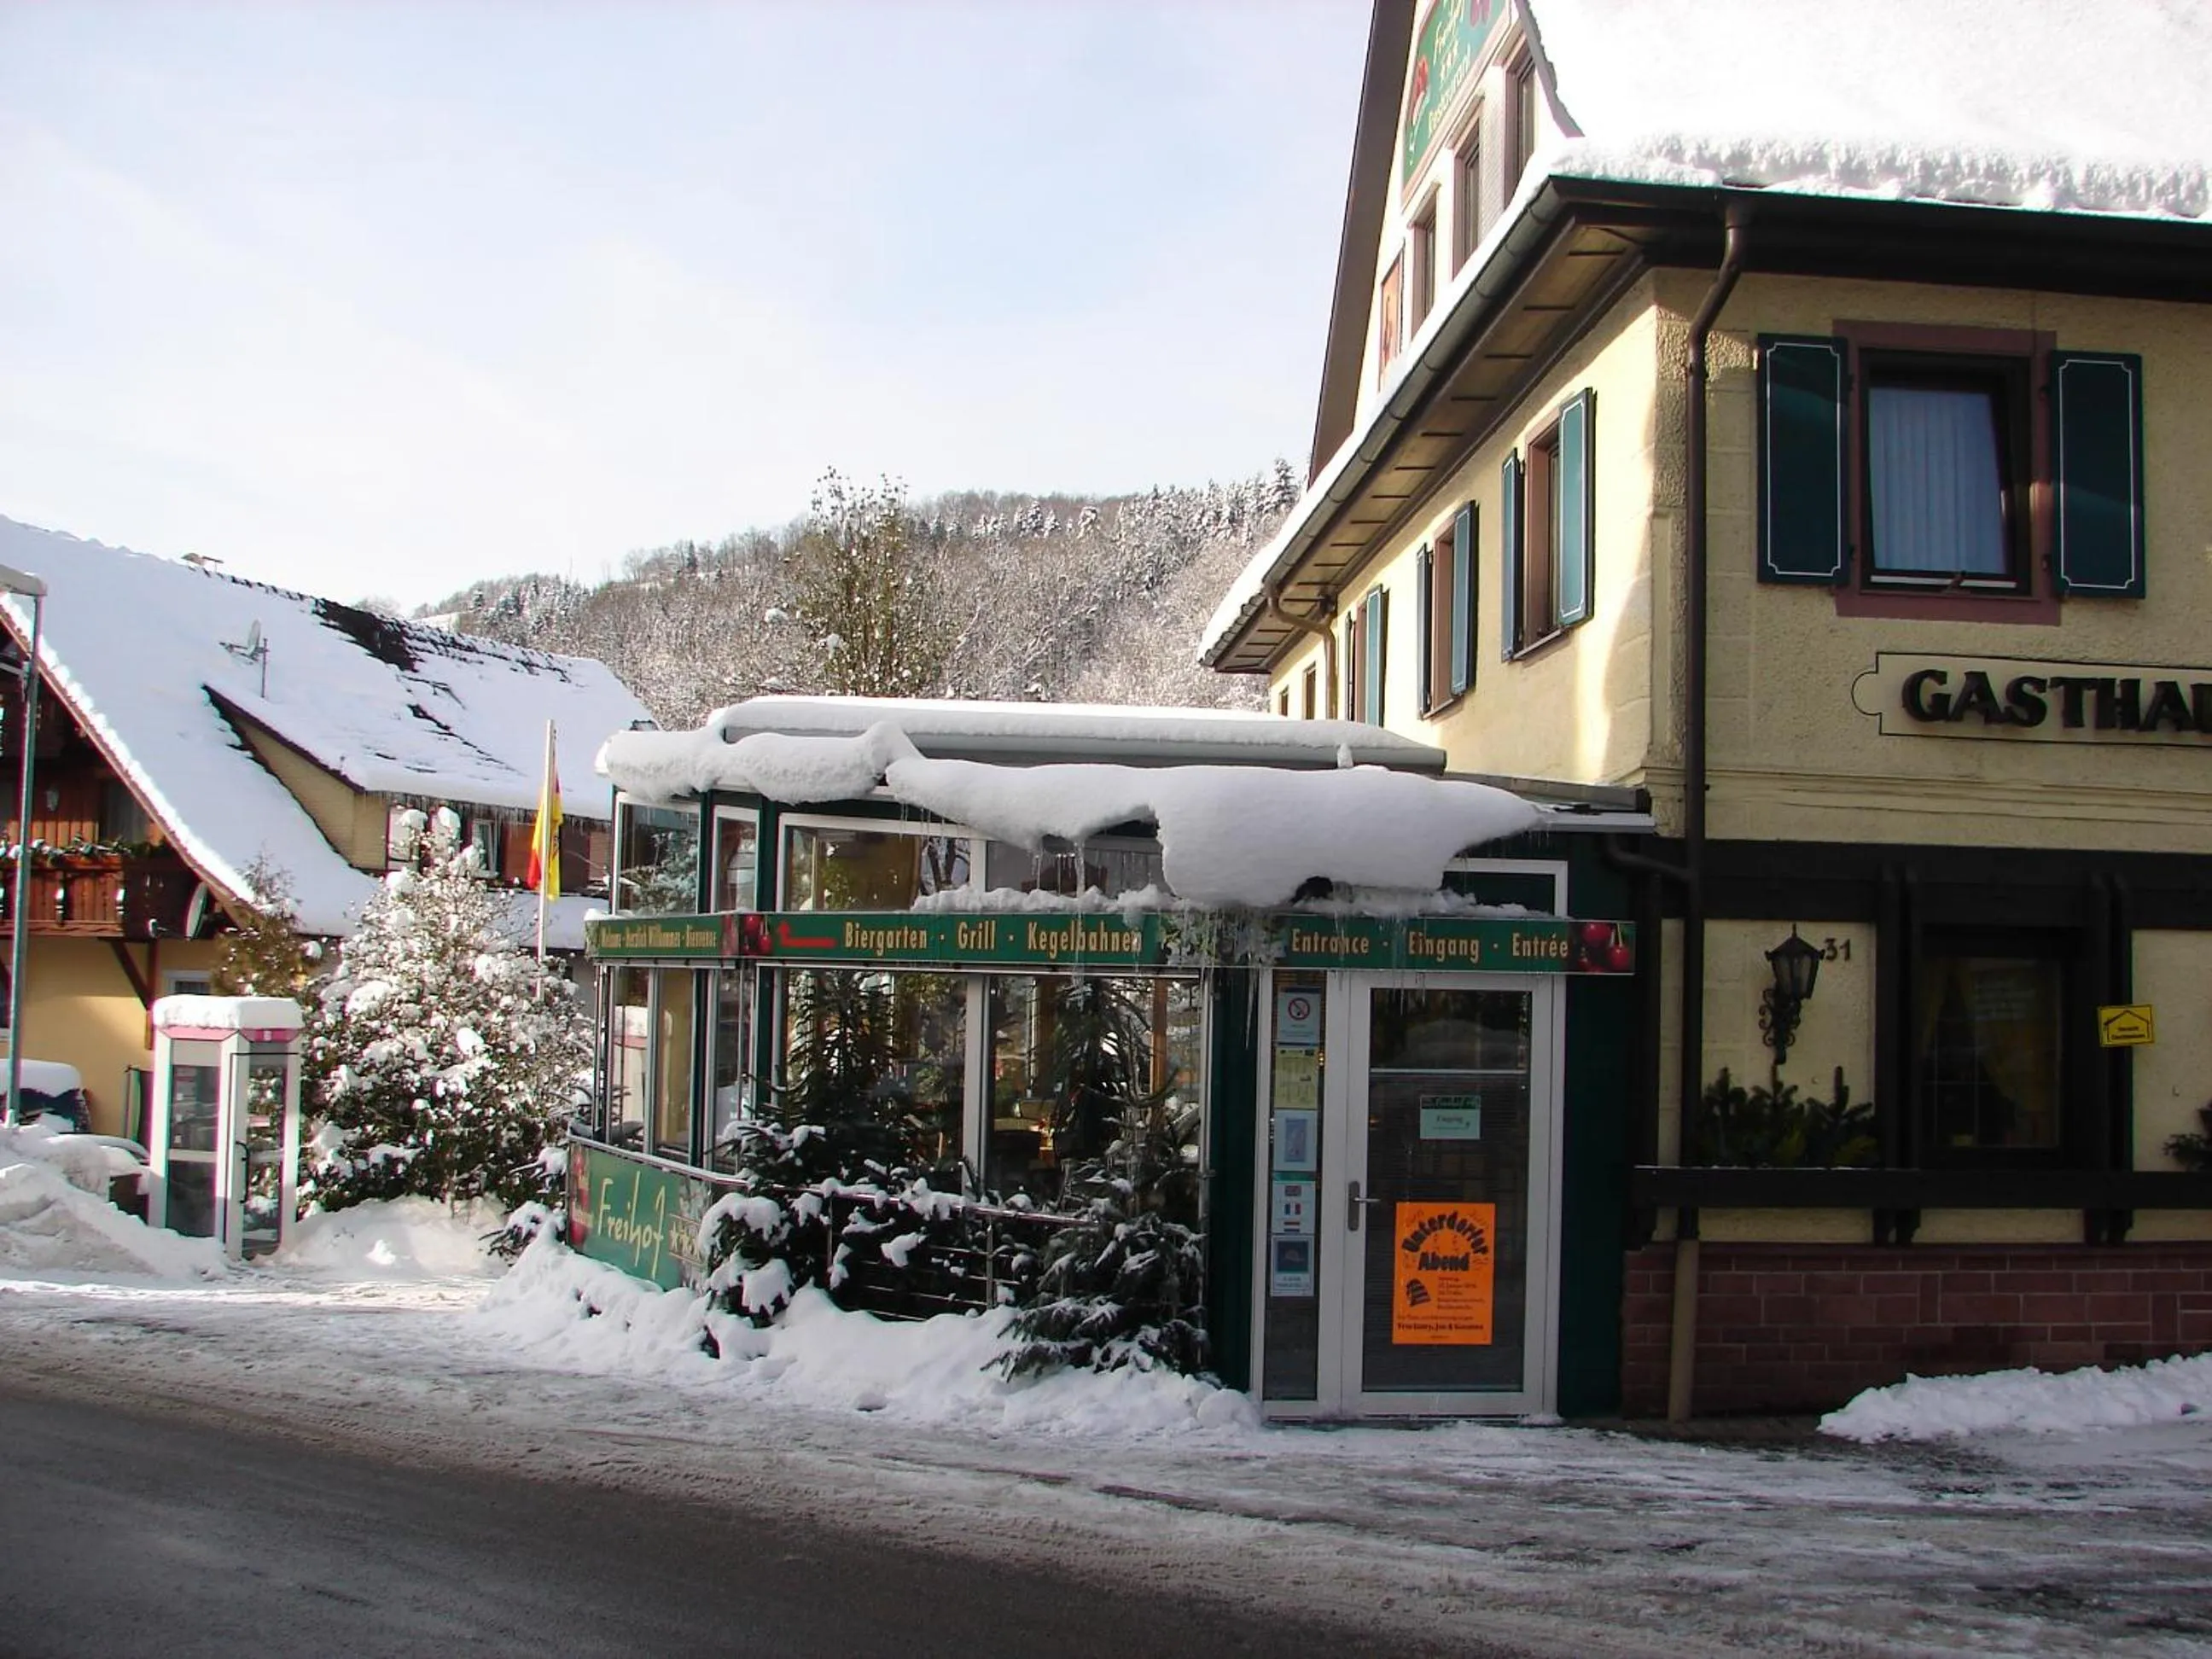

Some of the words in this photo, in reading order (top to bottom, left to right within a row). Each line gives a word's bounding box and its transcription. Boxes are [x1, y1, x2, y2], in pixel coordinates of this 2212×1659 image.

[844, 921, 928, 956] Biergarten
[958, 920, 997, 950] Grill
[1027, 920, 1143, 959] Kegelbahnen
[1291, 928, 1370, 954] Entrance
[1408, 931, 1481, 963] Eingang
[1511, 932, 1569, 958] Entrée
[1825, 937, 1851, 962] 31
[598, 1170, 664, 1281] Freihof
[1417, 1251, 1470, 1272] Abend
